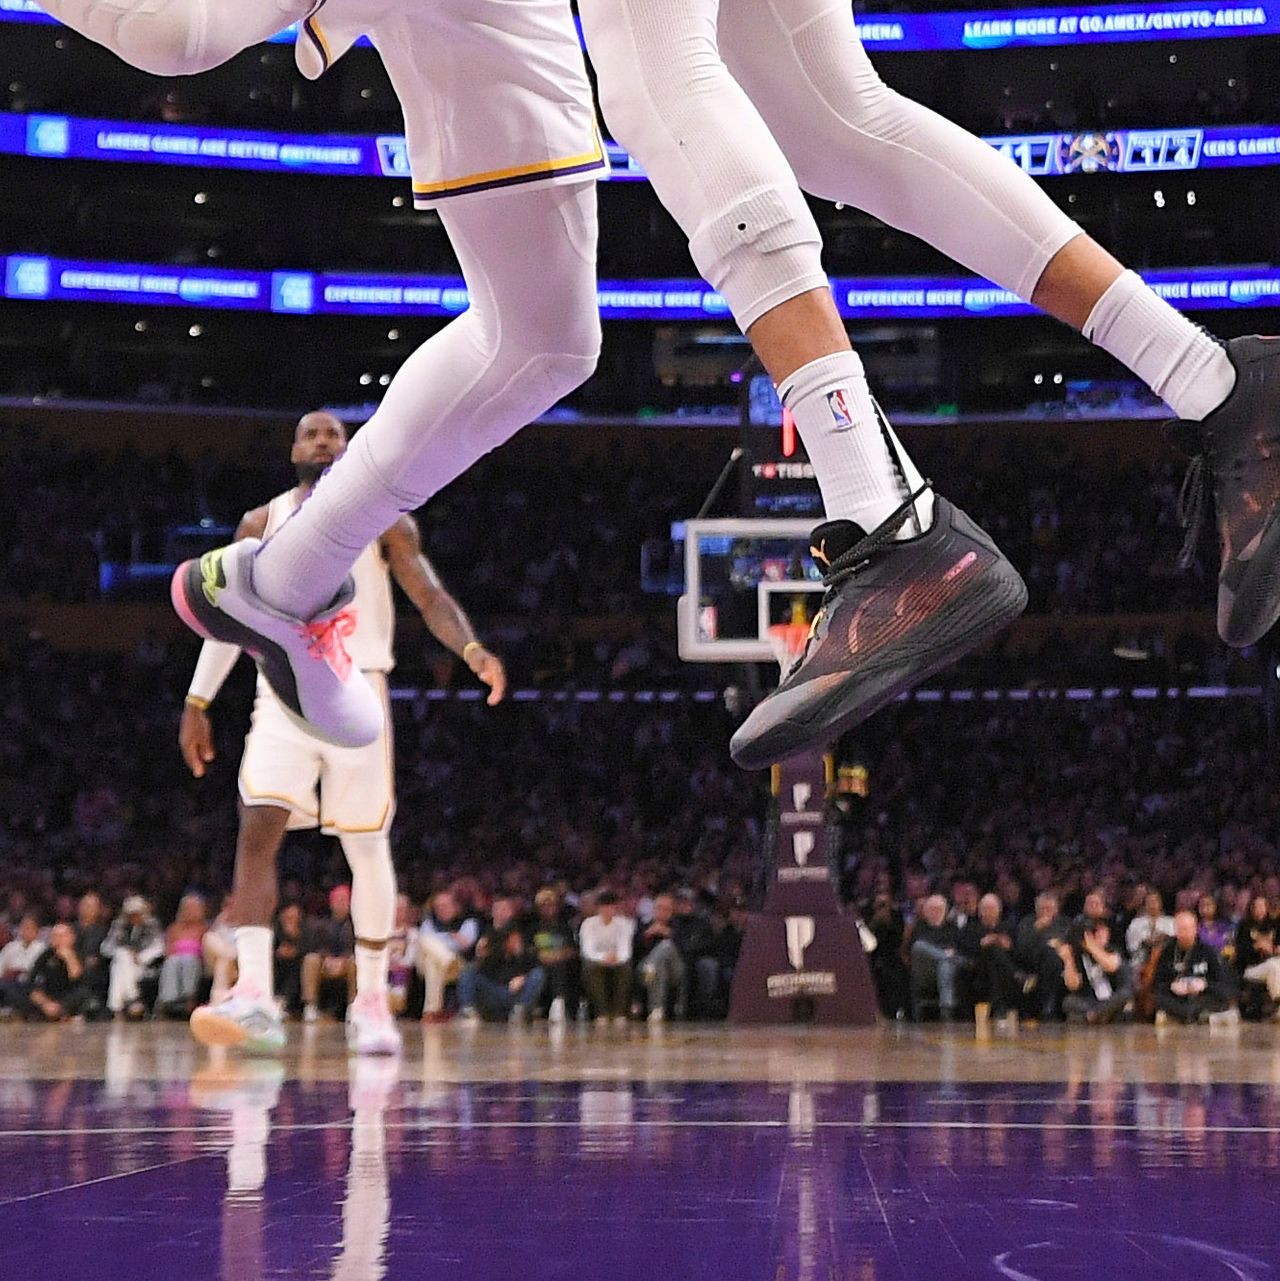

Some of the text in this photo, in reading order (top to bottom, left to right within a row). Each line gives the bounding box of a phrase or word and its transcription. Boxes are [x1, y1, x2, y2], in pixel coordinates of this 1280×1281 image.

[964, 20, 1014, 38] LEARN
[1015, 17, 1057, 36] MORE
[1058, 15, 1078, 34] AT
[1191, 280, 1229, 298] MORE
